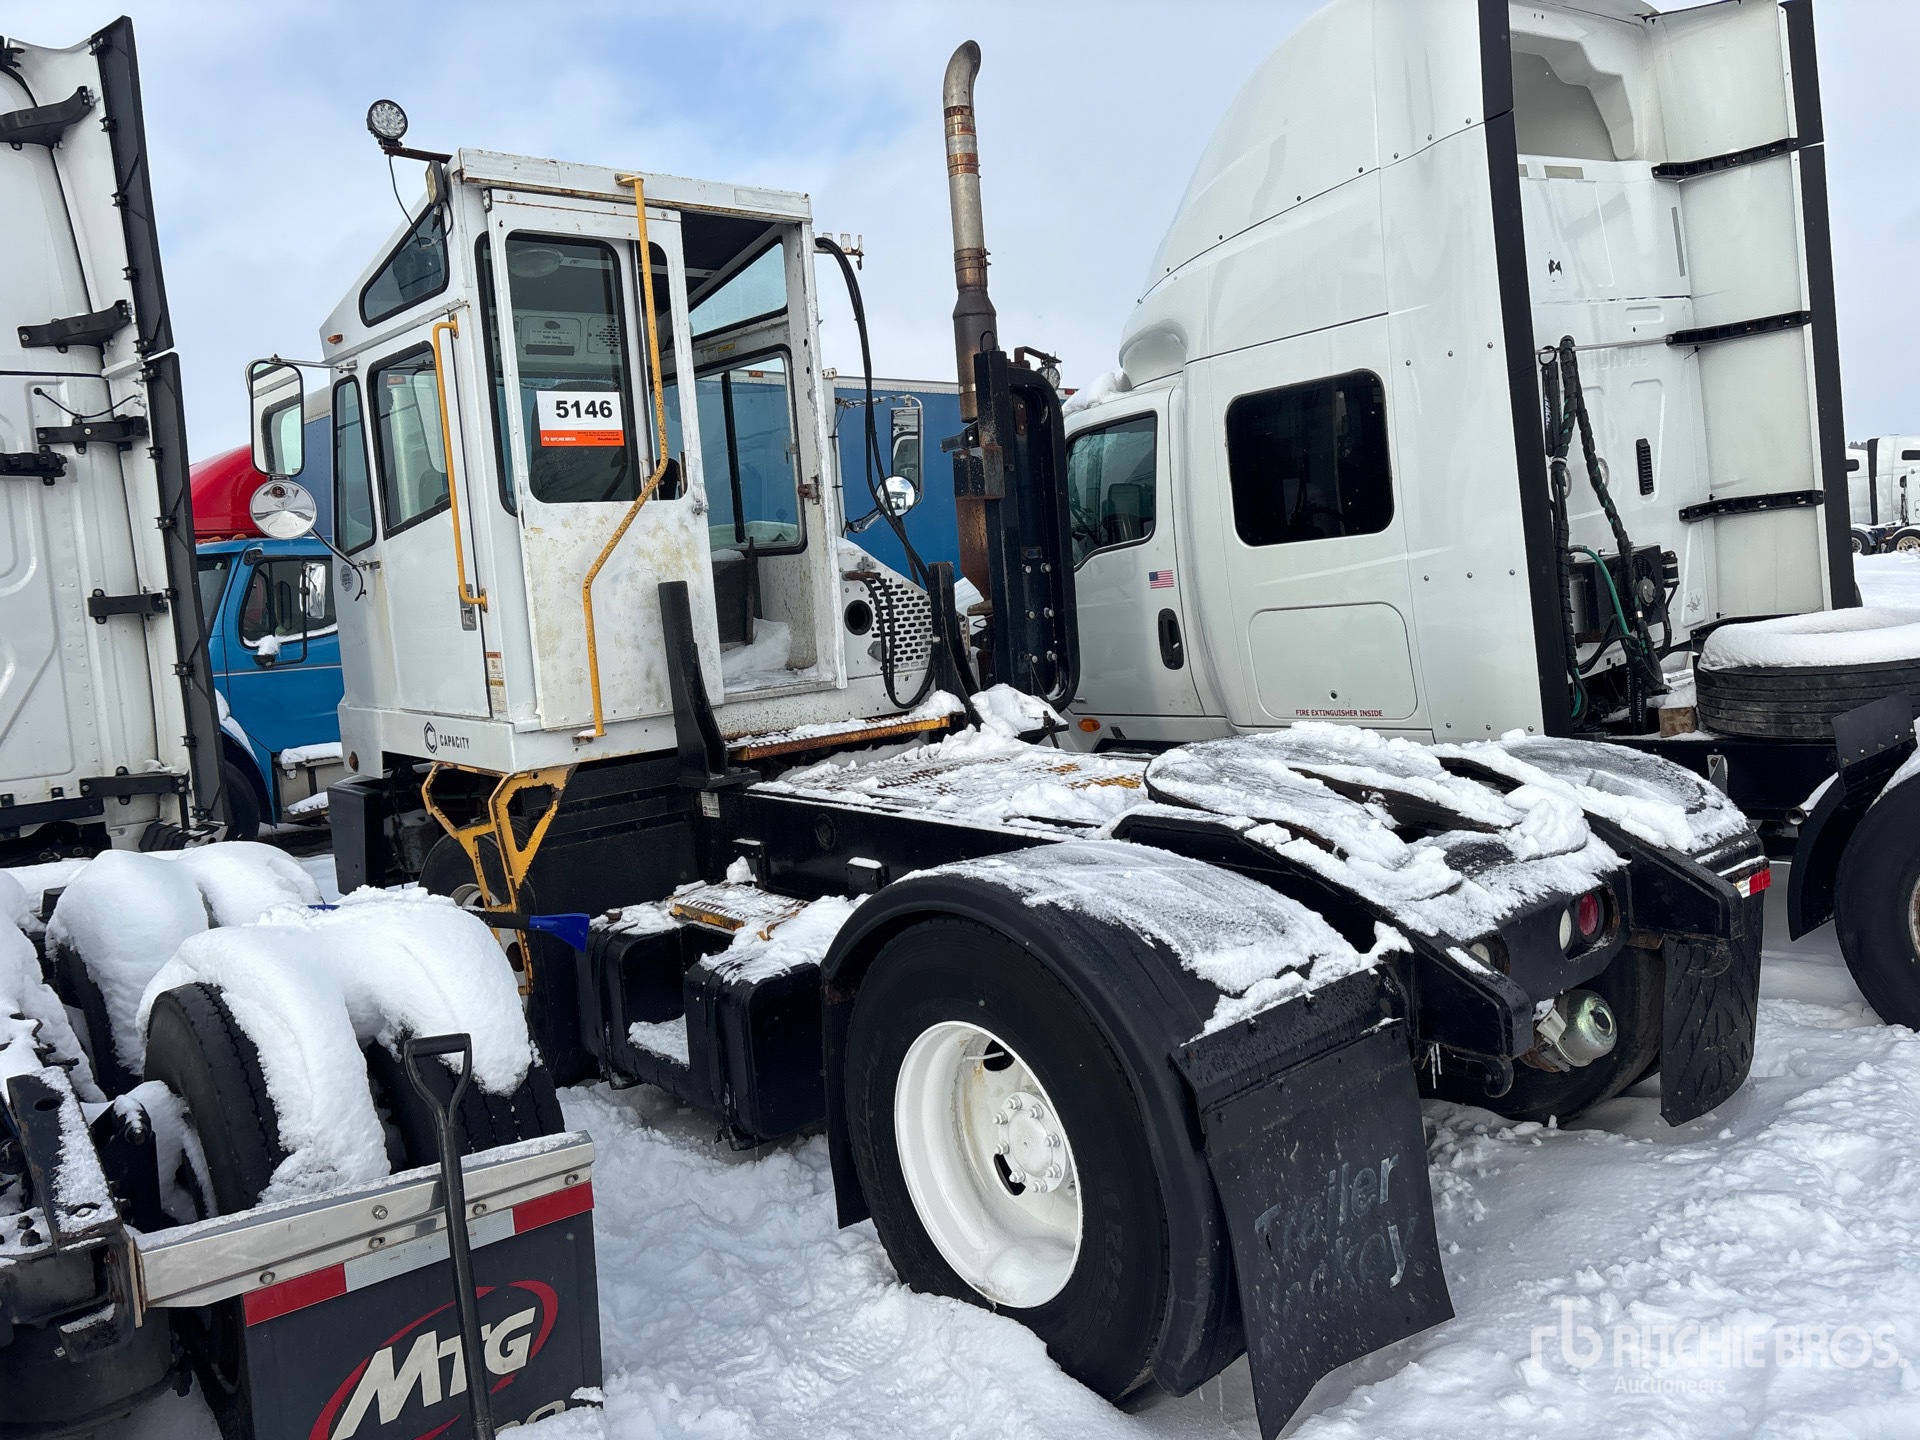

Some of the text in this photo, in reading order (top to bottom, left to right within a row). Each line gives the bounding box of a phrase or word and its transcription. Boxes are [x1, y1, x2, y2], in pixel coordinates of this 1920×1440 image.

[555, 400, 613, 418] 5146
[1295, 709, 1383, 717] FIRE EXTINGUISHER INSIDE
[440, 734, 470, 750] CAPACITY
